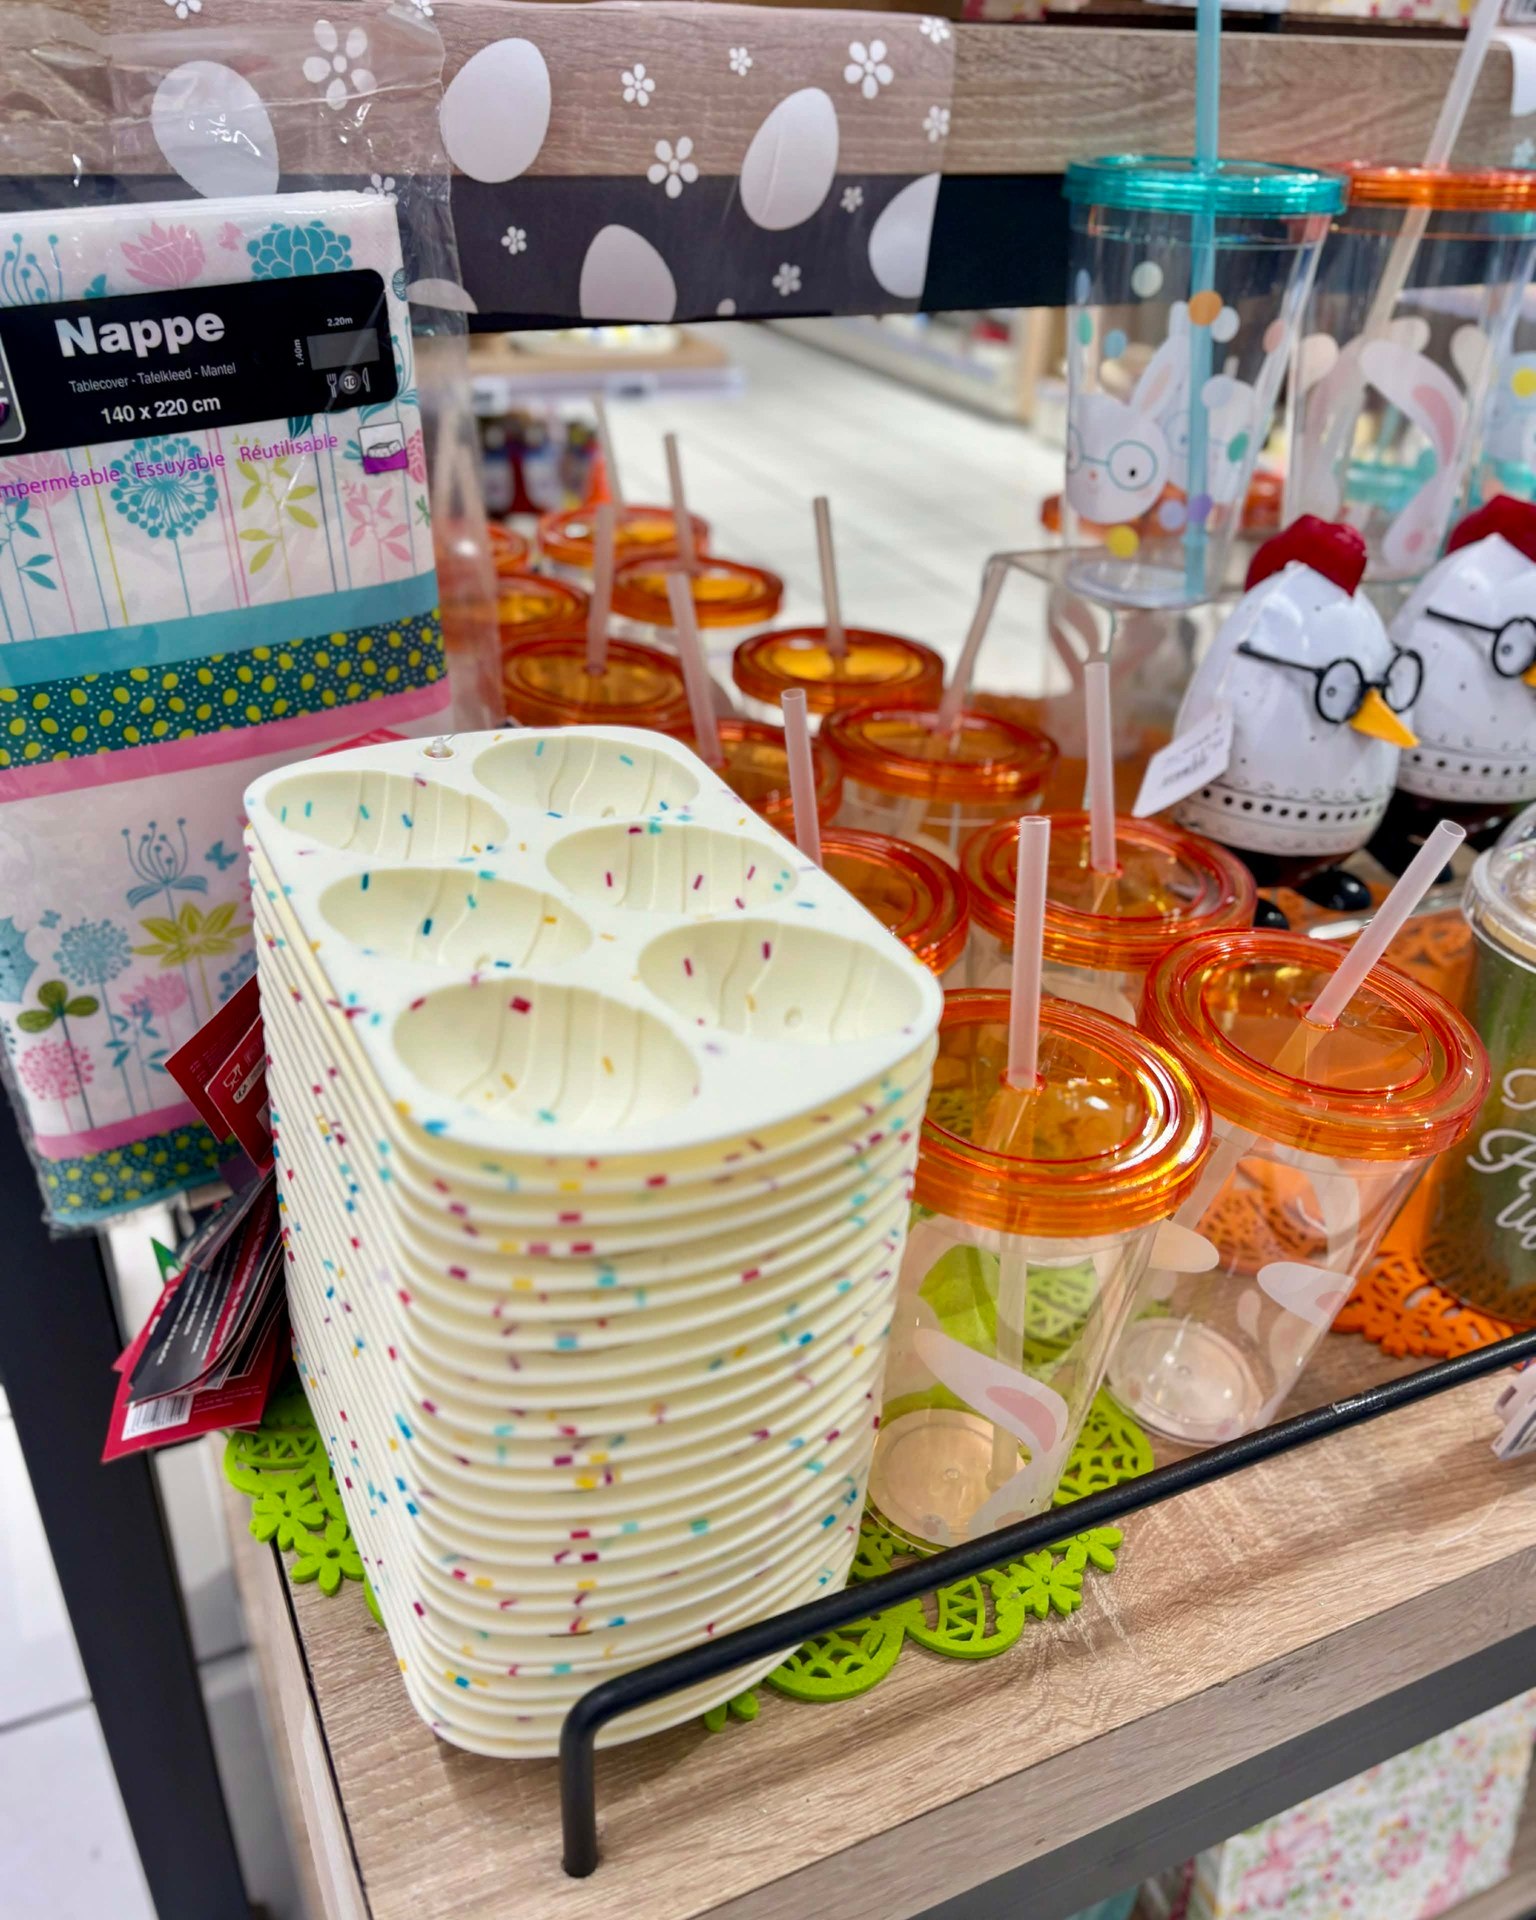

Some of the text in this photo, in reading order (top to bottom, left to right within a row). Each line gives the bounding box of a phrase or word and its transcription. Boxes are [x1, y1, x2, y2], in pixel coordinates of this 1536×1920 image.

[54, 312, 226, 359] Nappe
[68, 376, 130, 394] Tablecover
[137, 367, 193, 386] Tafelkleed
[200, 362, 237, 378] Mantel
[100, 396, 222, 425] 140 x 220 cm
[134, 451, 226, 479] Essuyable
[239, 433, 339, 463] Réutilisable
